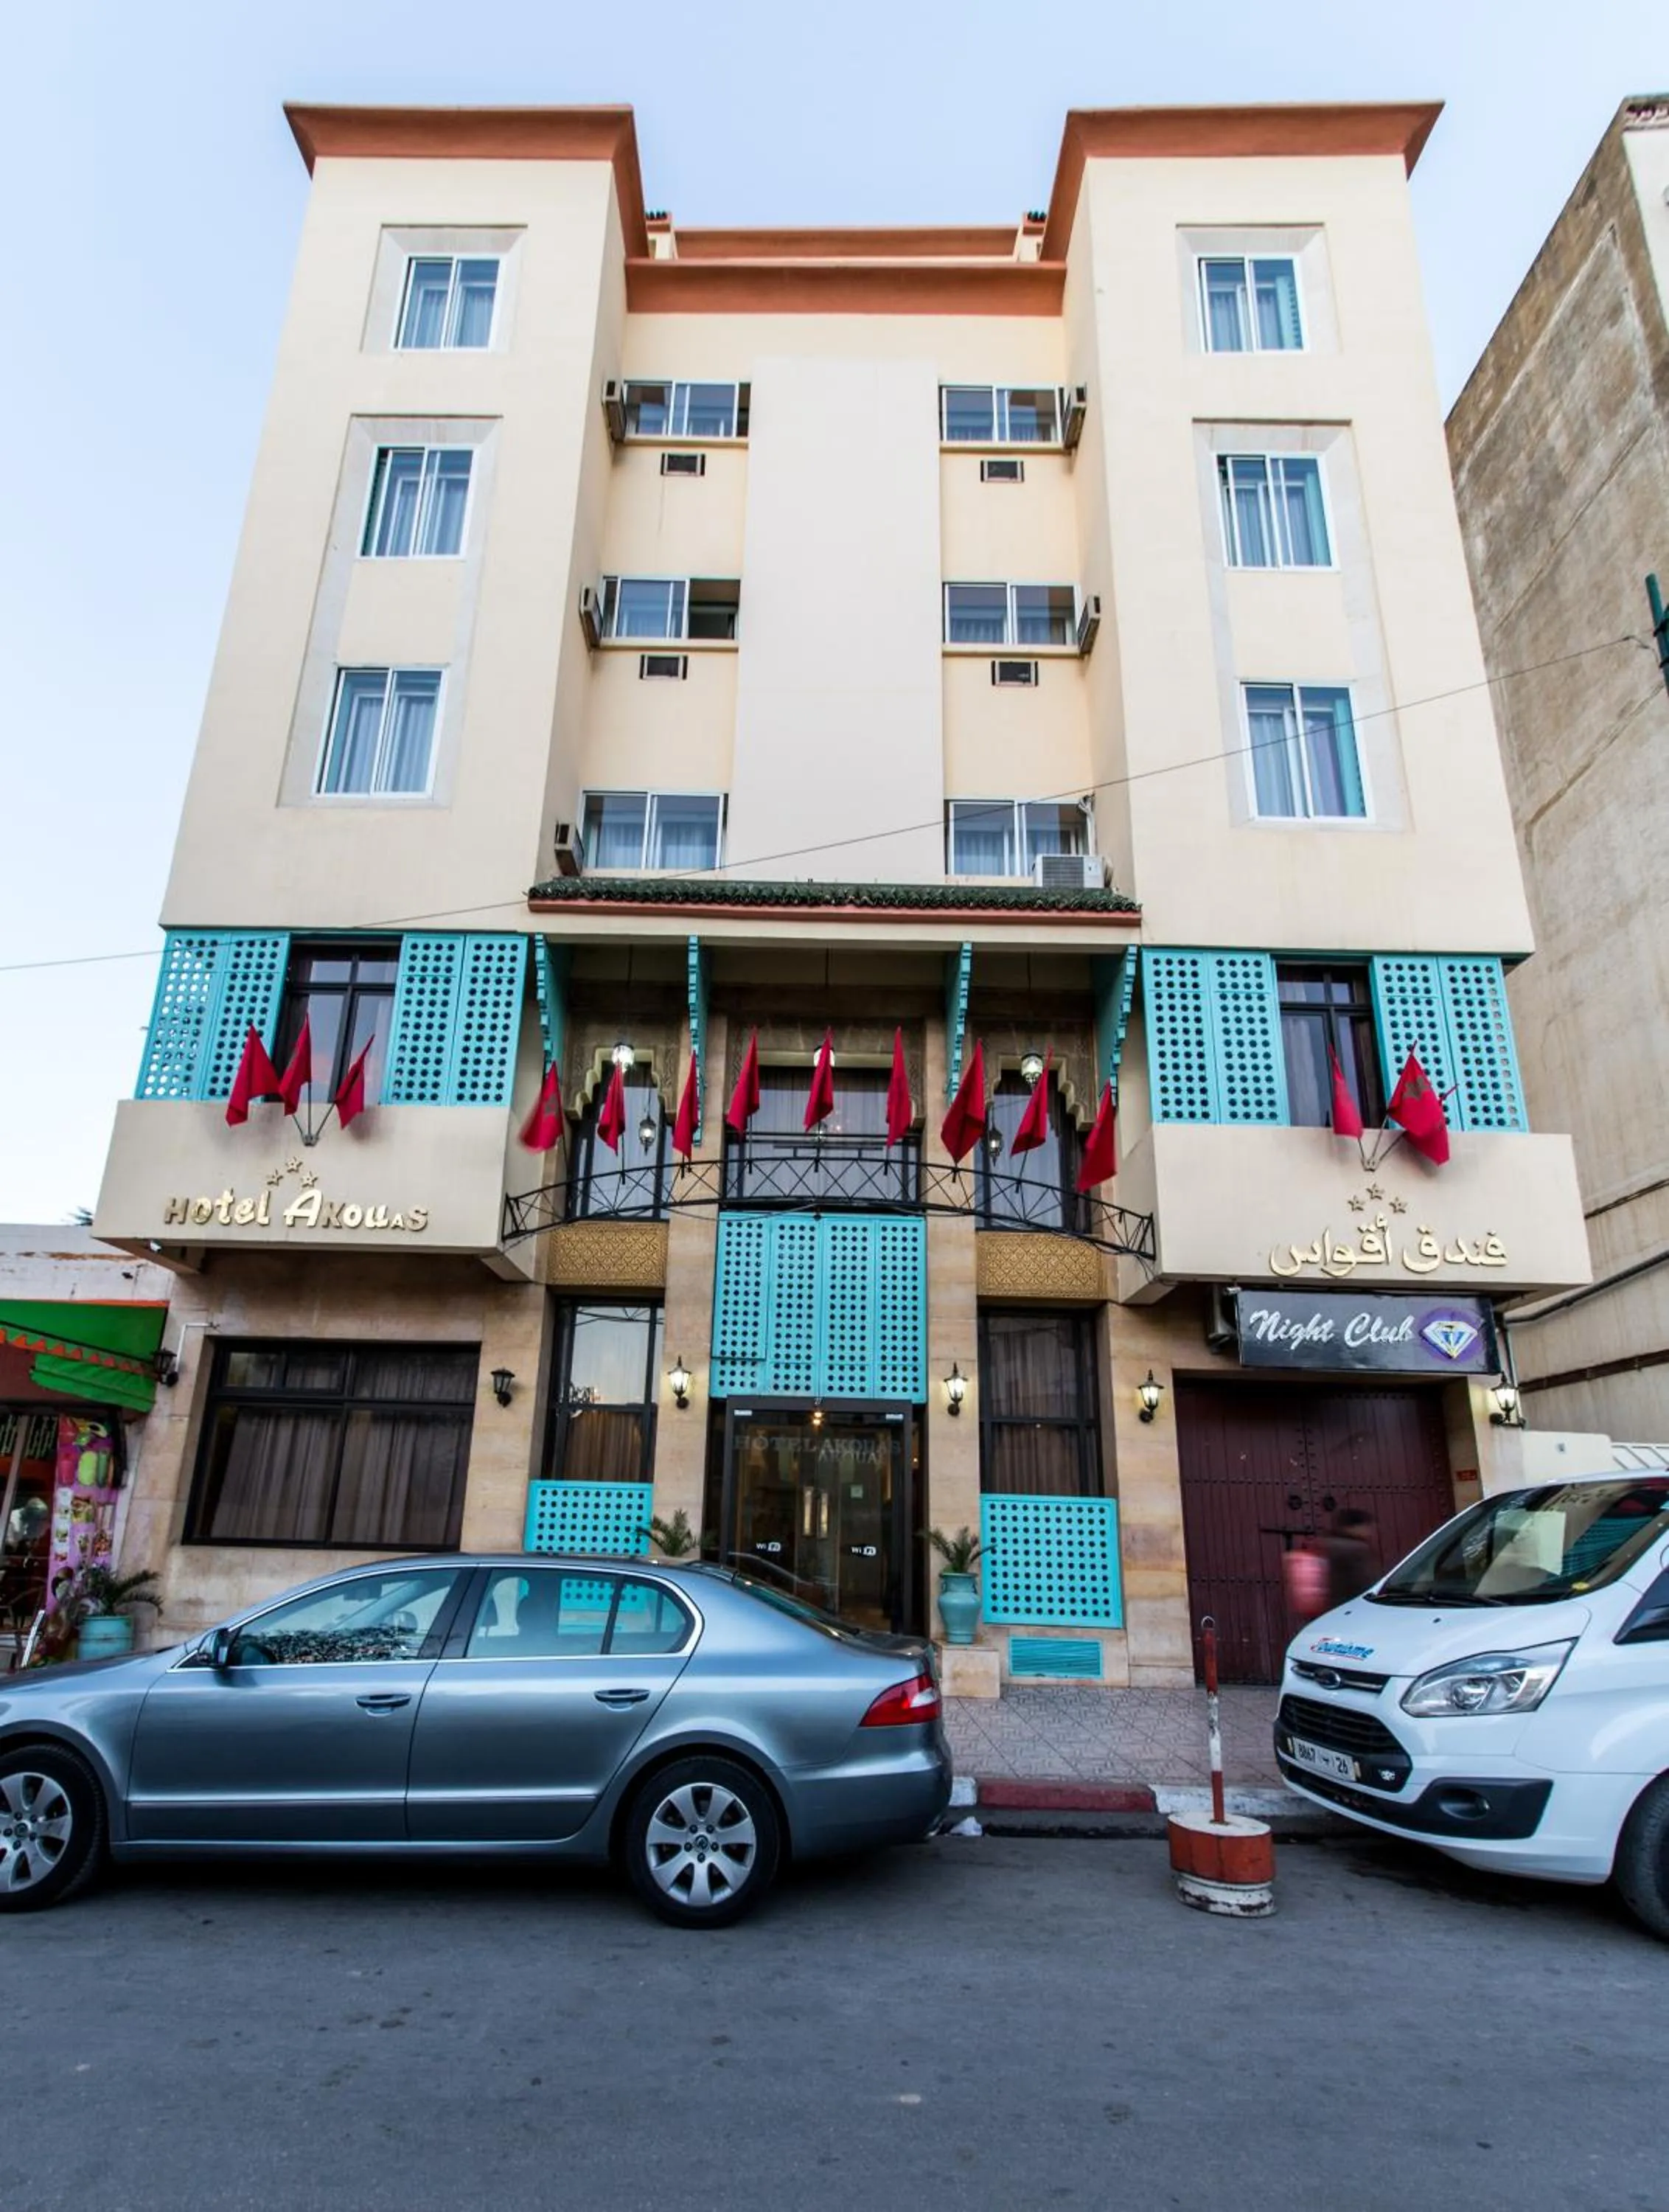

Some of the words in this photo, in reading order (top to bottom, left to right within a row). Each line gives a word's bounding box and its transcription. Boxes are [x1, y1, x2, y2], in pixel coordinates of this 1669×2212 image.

[1269, 1213, 1393, 1277] أقواس
[1401, 1224, 1510, 1274] فندق
[1250, 1309, 1335, 1351] Night
[1344, 1312, 1416, 1349] Club
